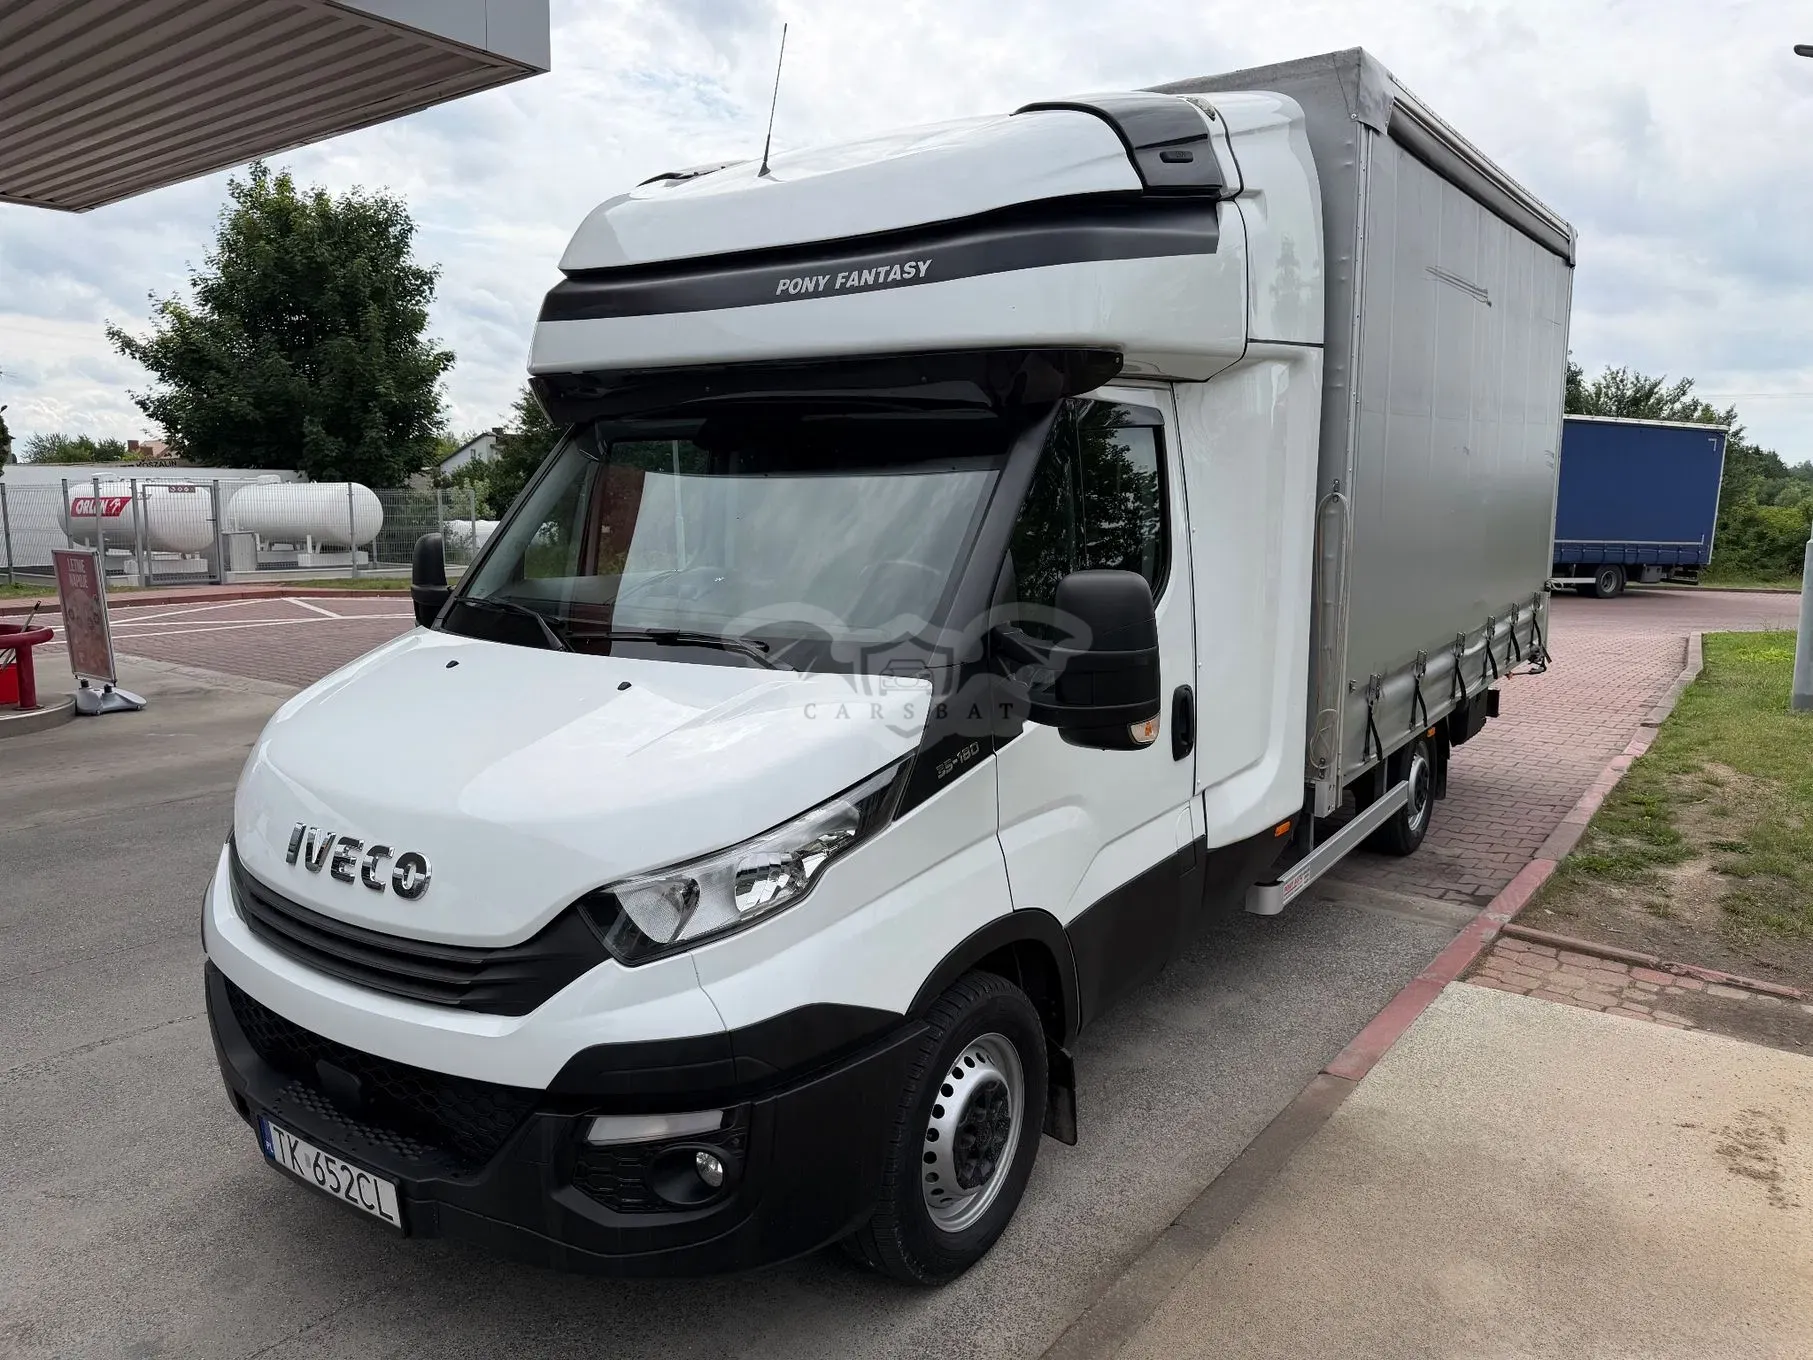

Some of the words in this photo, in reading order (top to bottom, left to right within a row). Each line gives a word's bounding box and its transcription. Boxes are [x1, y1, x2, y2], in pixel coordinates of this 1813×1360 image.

[775, 274, 831, 296] PONY
[835, 259, 932, 289] FANTASY
[76, 499, 108, 515] ORLN
[936, 741, 980, 779] 35-180
[285, 821, 433, 901] IVECO
[272, 1126, 305, 1176] TK
[312, 1151, 394, 1222] 652CL
